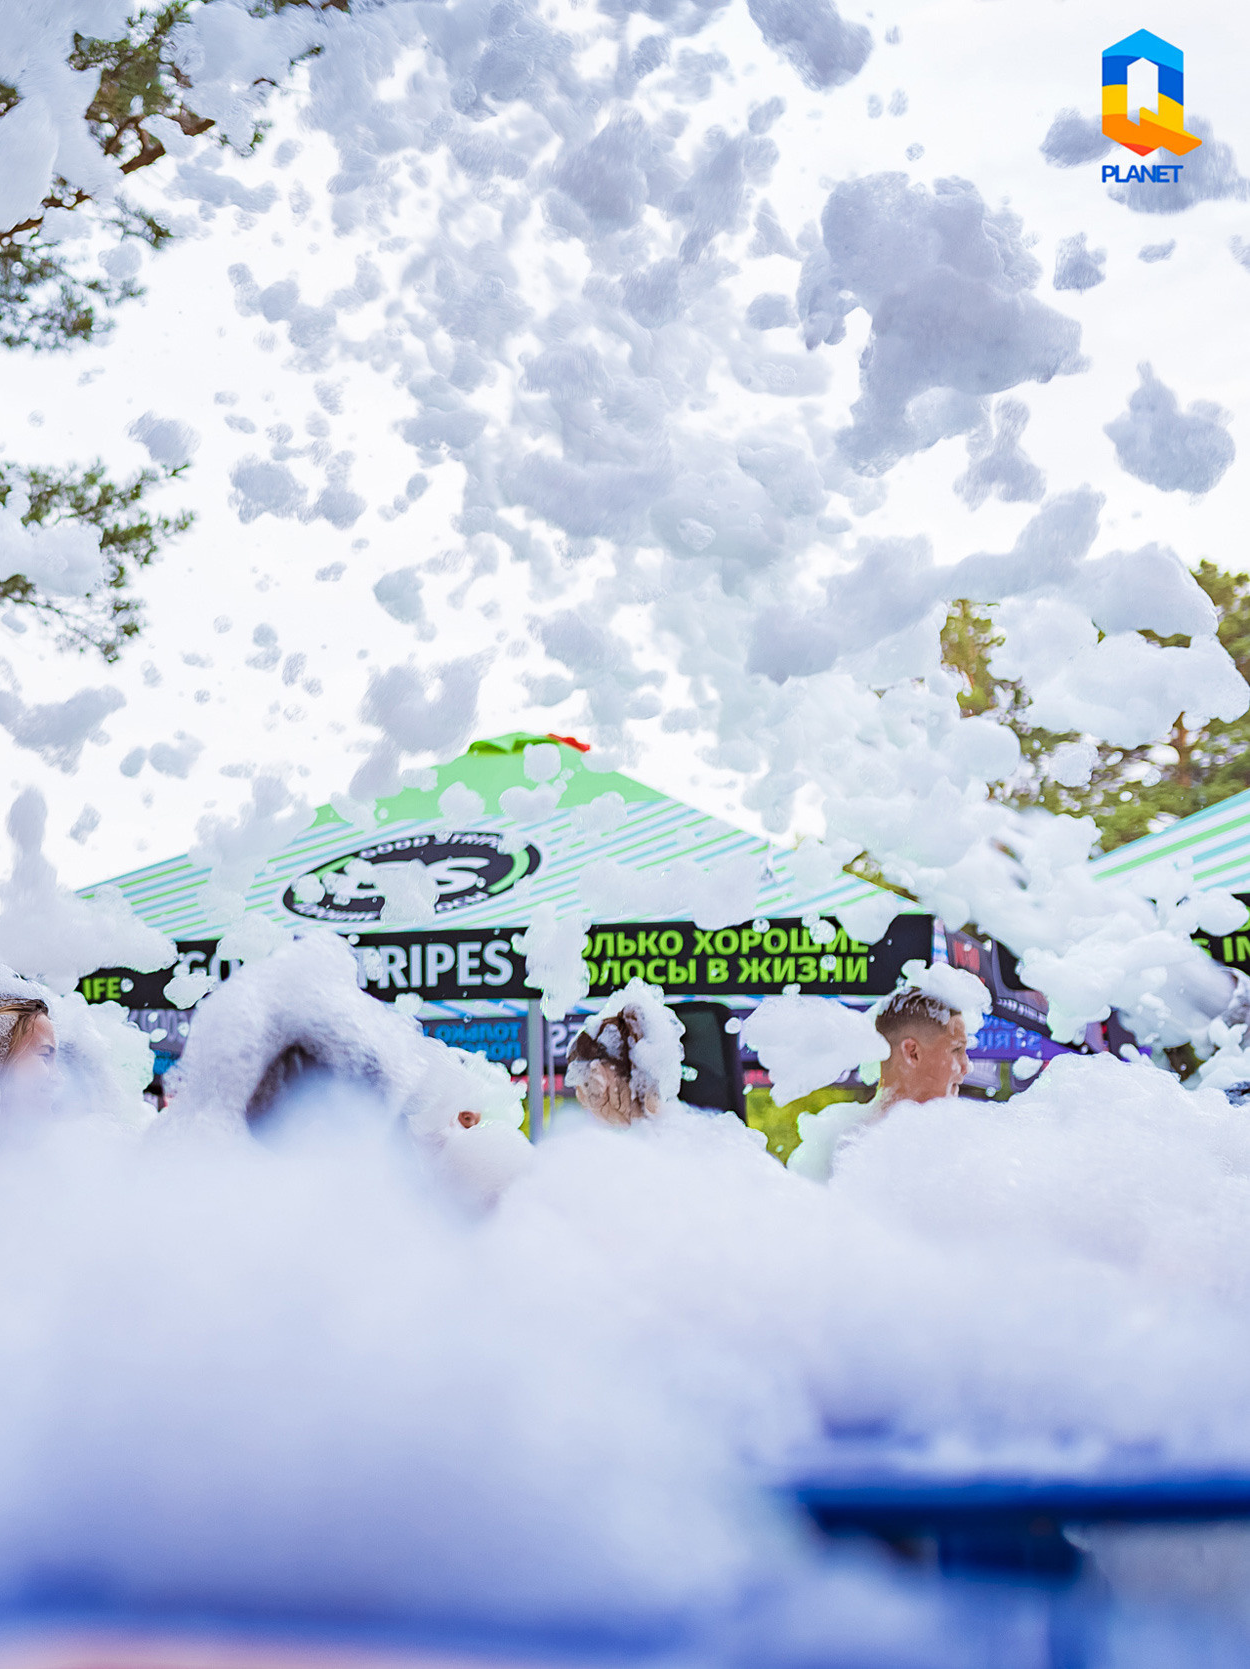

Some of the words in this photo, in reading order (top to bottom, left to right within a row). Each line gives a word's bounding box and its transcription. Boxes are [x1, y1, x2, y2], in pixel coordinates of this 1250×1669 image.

[581, 930, 684, 958] ЛЬКО
[354, 940, 513, 988] TRIPES
[586, 958, 697, 986] ЛОСЫ
[707, 957, 730, 984] В
[737, 956, 868, 983] ЖИЗНИ
[82, 976, 122, 1000] IFE
